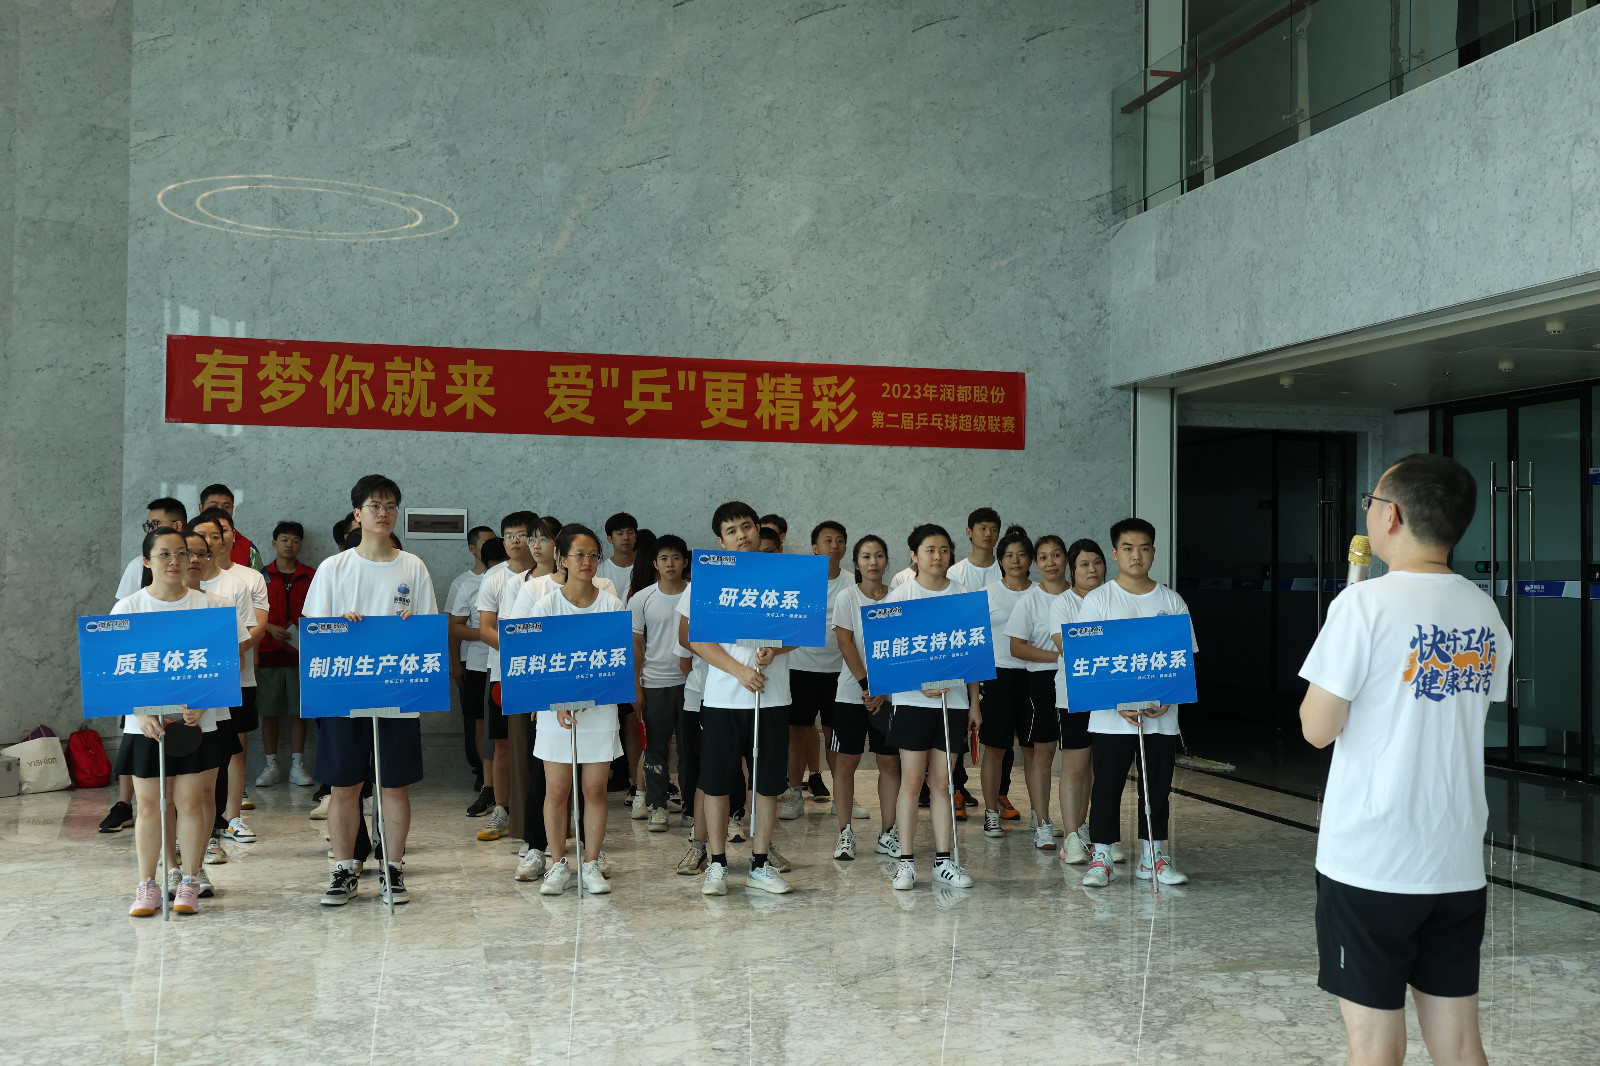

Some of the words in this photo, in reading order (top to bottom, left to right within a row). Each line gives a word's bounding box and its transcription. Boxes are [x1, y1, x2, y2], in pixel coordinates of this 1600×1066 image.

[192, 348, 497, 420] 有梦你就来
[881, 382, 1006, 404] 2023年润都股份
[871, 409, 1016, 434] 第二届乒乓球超级联赛
[718, 587, 800, 610] 研发体系
[871, 626, 986, 659] 职能支持体系
[1409, 624, 1497, 665] 快乐工作
[113, 648, 208, 676] 质量体系
[308, 652, 442, 679] 制剂生产体系
[506, 647, 627, 677] 原料生产体系
[1072, 649, 1187, 677] 生产支持体系
[1409, 662, 1493, 702] 健康生活
